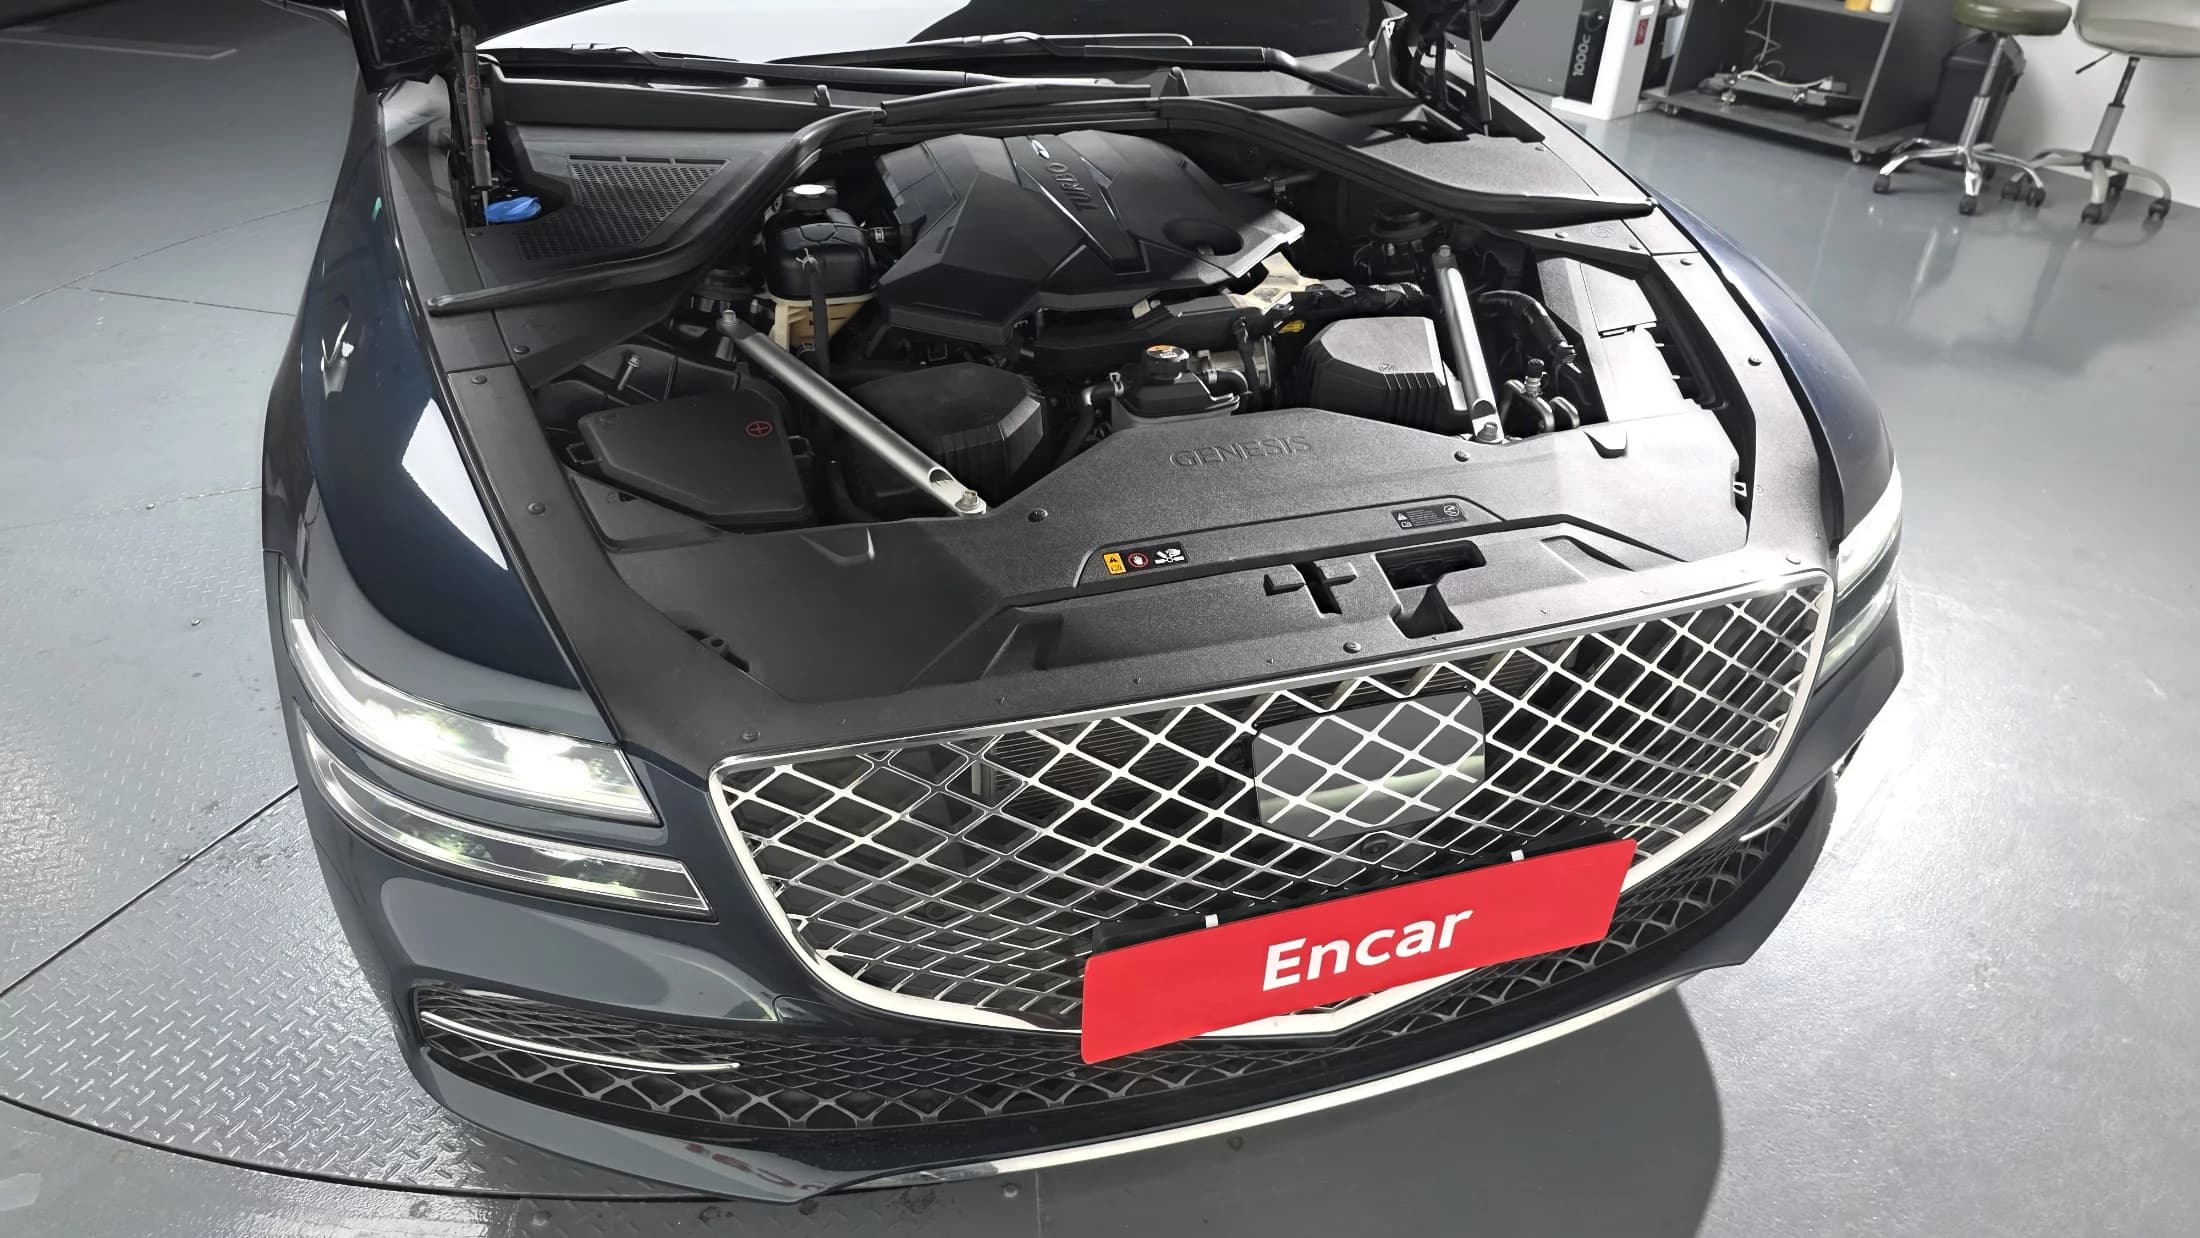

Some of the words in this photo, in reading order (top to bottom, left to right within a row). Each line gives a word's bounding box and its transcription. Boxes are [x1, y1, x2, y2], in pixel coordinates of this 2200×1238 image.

[1047, 162, 1099, 210] TURBO
[1169, 435, 1312, 467] GENESIS
[1262, 909, 1474, 992] Encar
